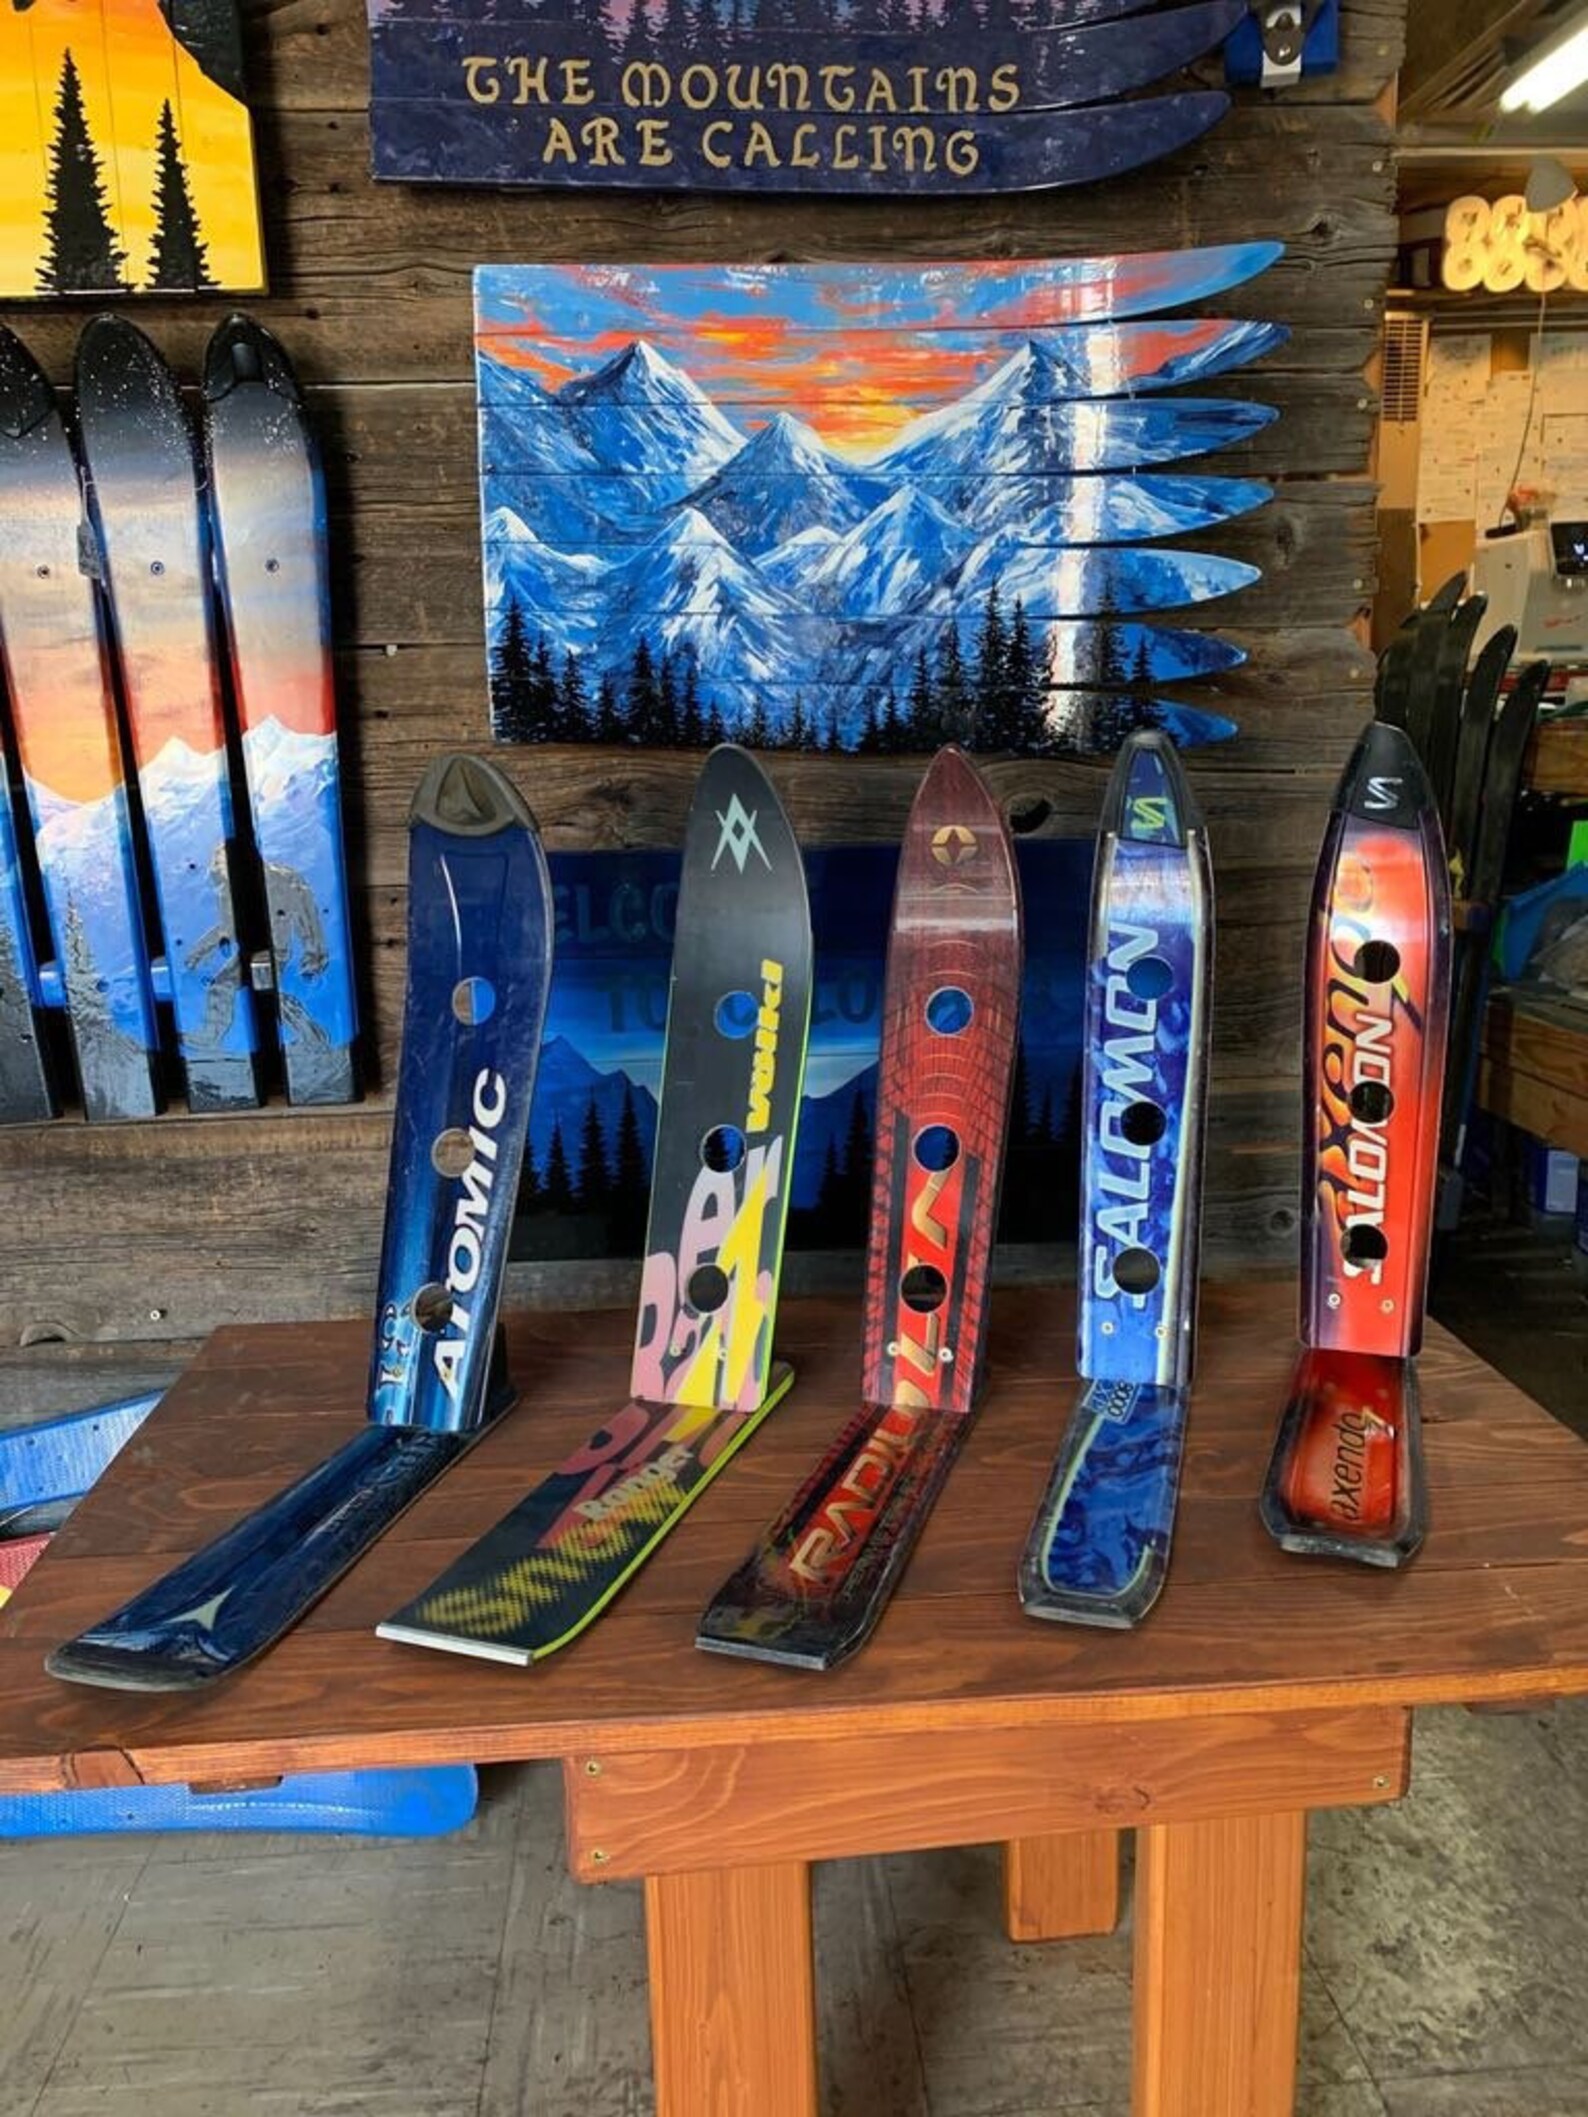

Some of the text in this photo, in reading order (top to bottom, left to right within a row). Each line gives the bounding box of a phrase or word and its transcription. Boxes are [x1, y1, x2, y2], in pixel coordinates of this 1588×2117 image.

[462, 56, 1020, 113] THE MOUNTAINS
[543, 117, 979, 175] ARE CALLING
[433, 1067, 507, 1402] ATOMIC
[1330, 1411, 1367, 1521] axendo
